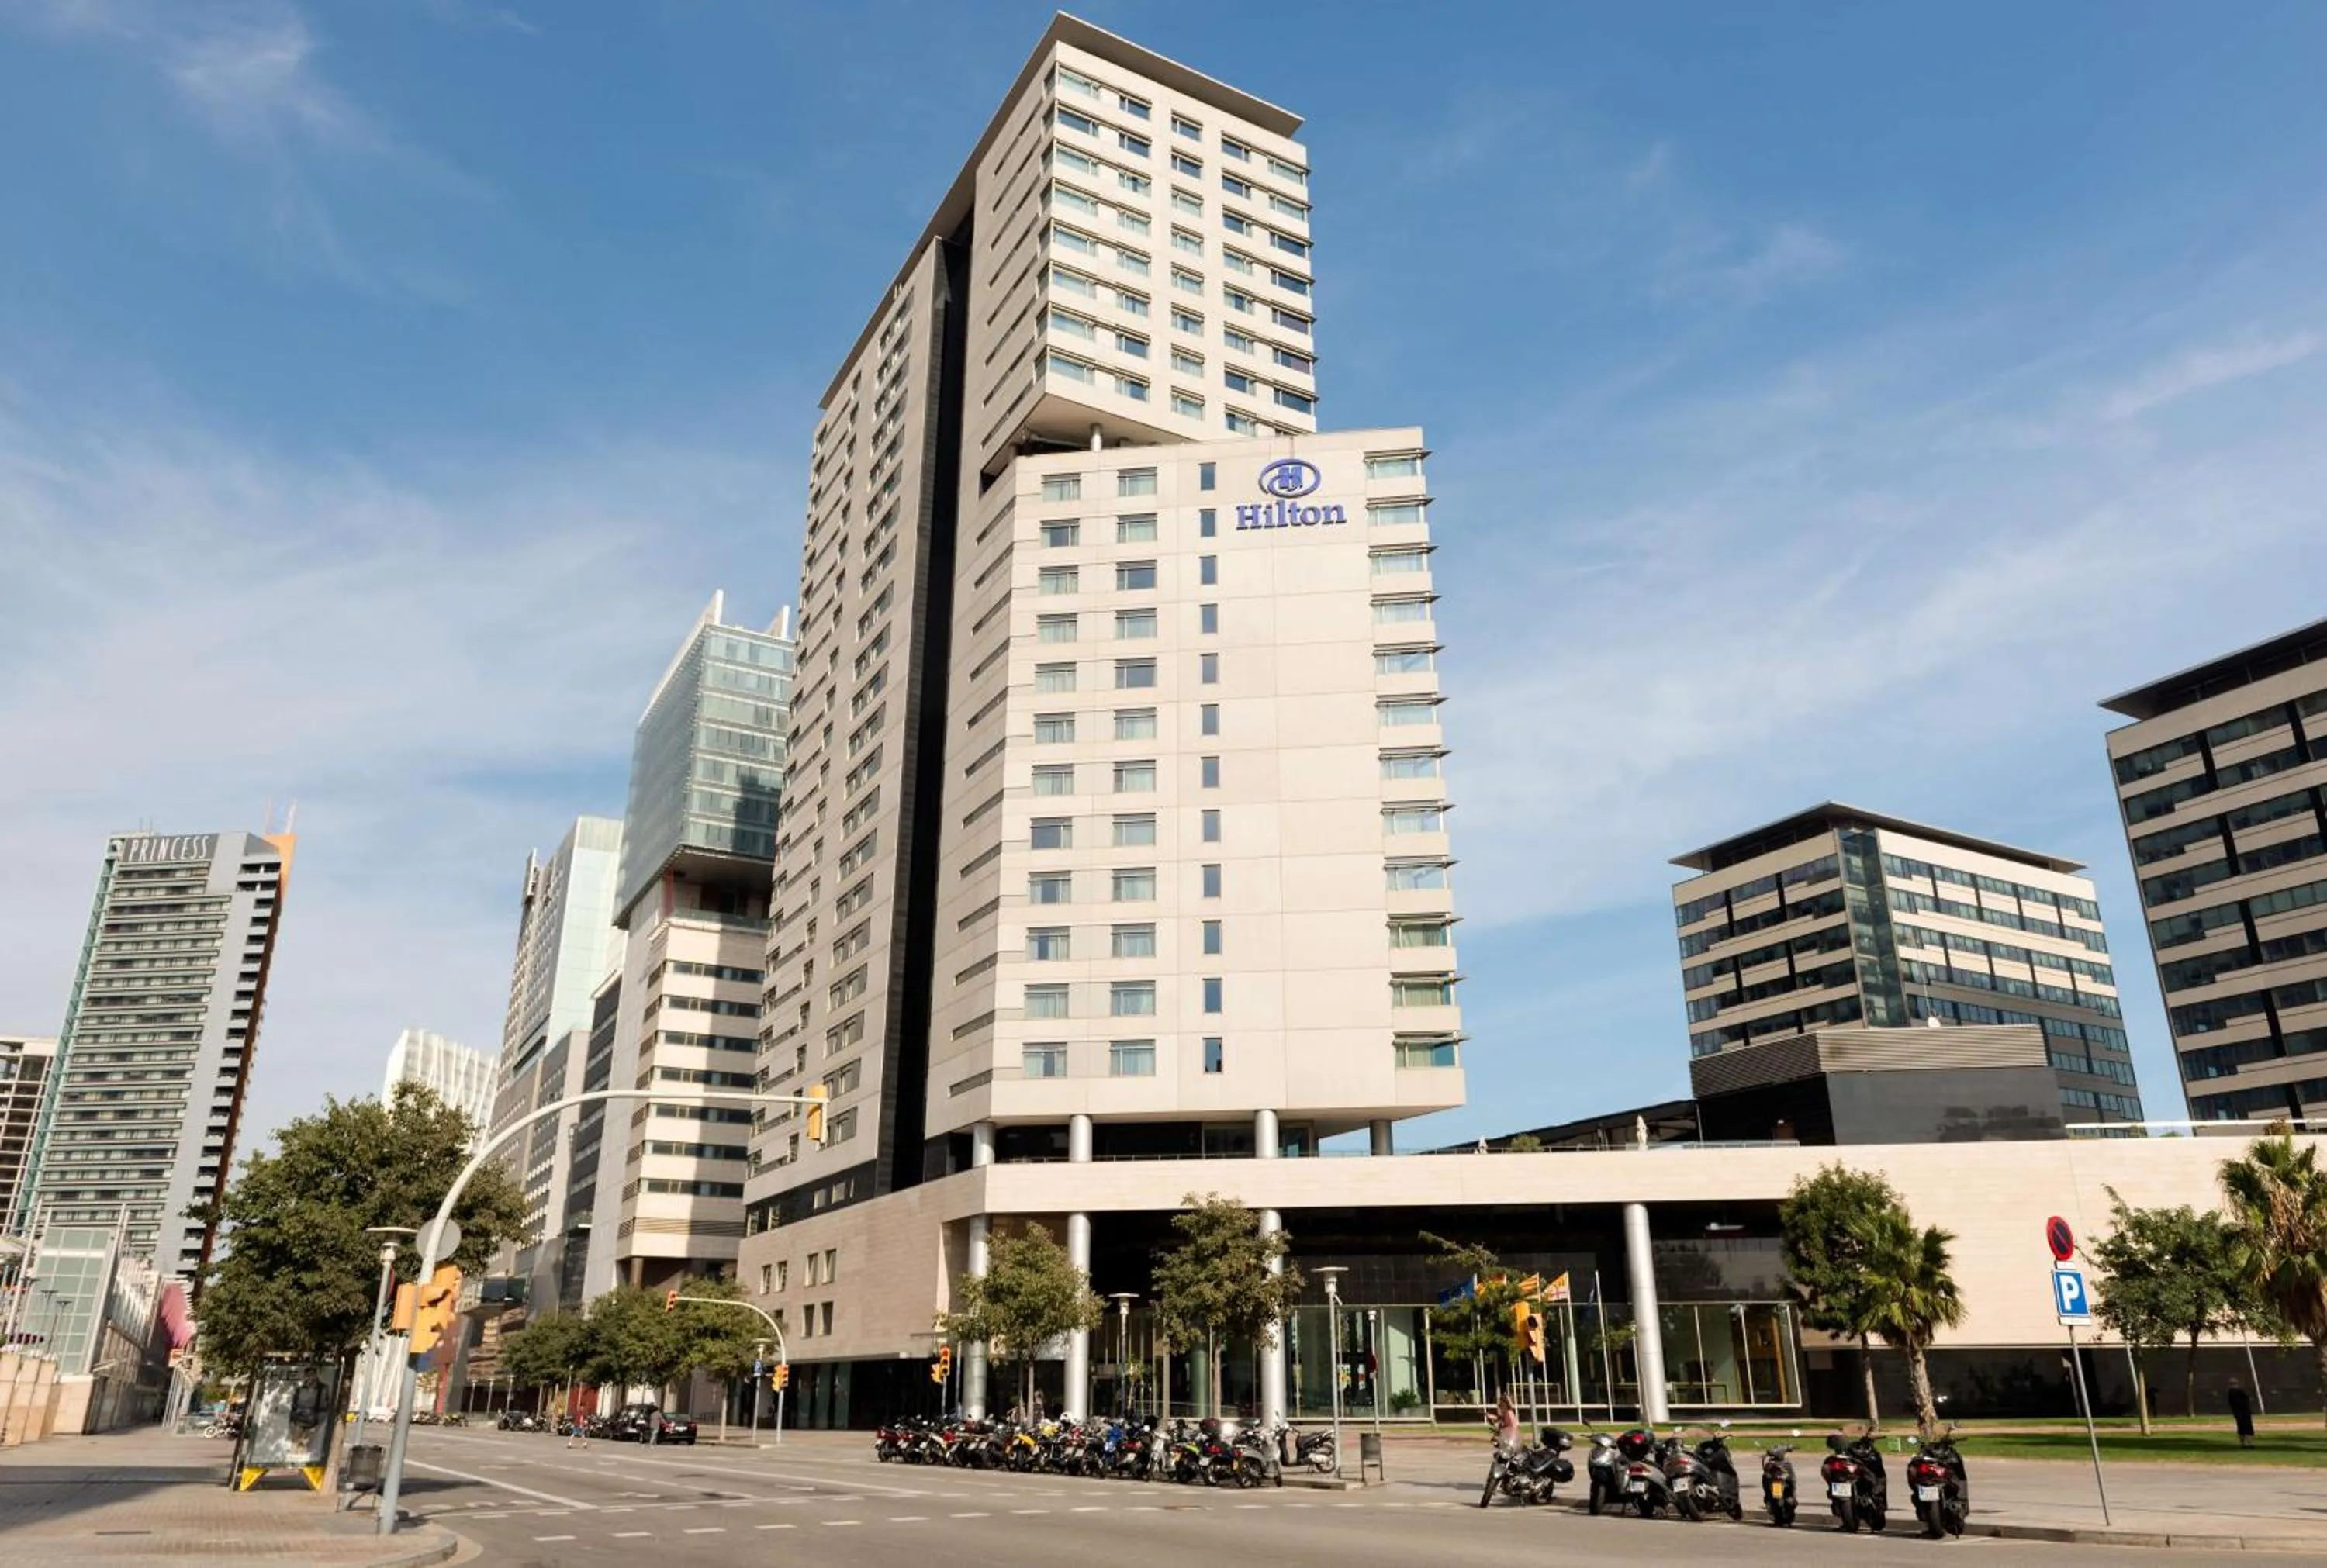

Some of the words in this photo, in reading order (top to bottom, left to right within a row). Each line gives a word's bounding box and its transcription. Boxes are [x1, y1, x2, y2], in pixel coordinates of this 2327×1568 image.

[1236, 499, 1347, 530] Hilton
[128, 836, 210, 862] PRINCESS
[2059, 1274, 2080, 1311] P
